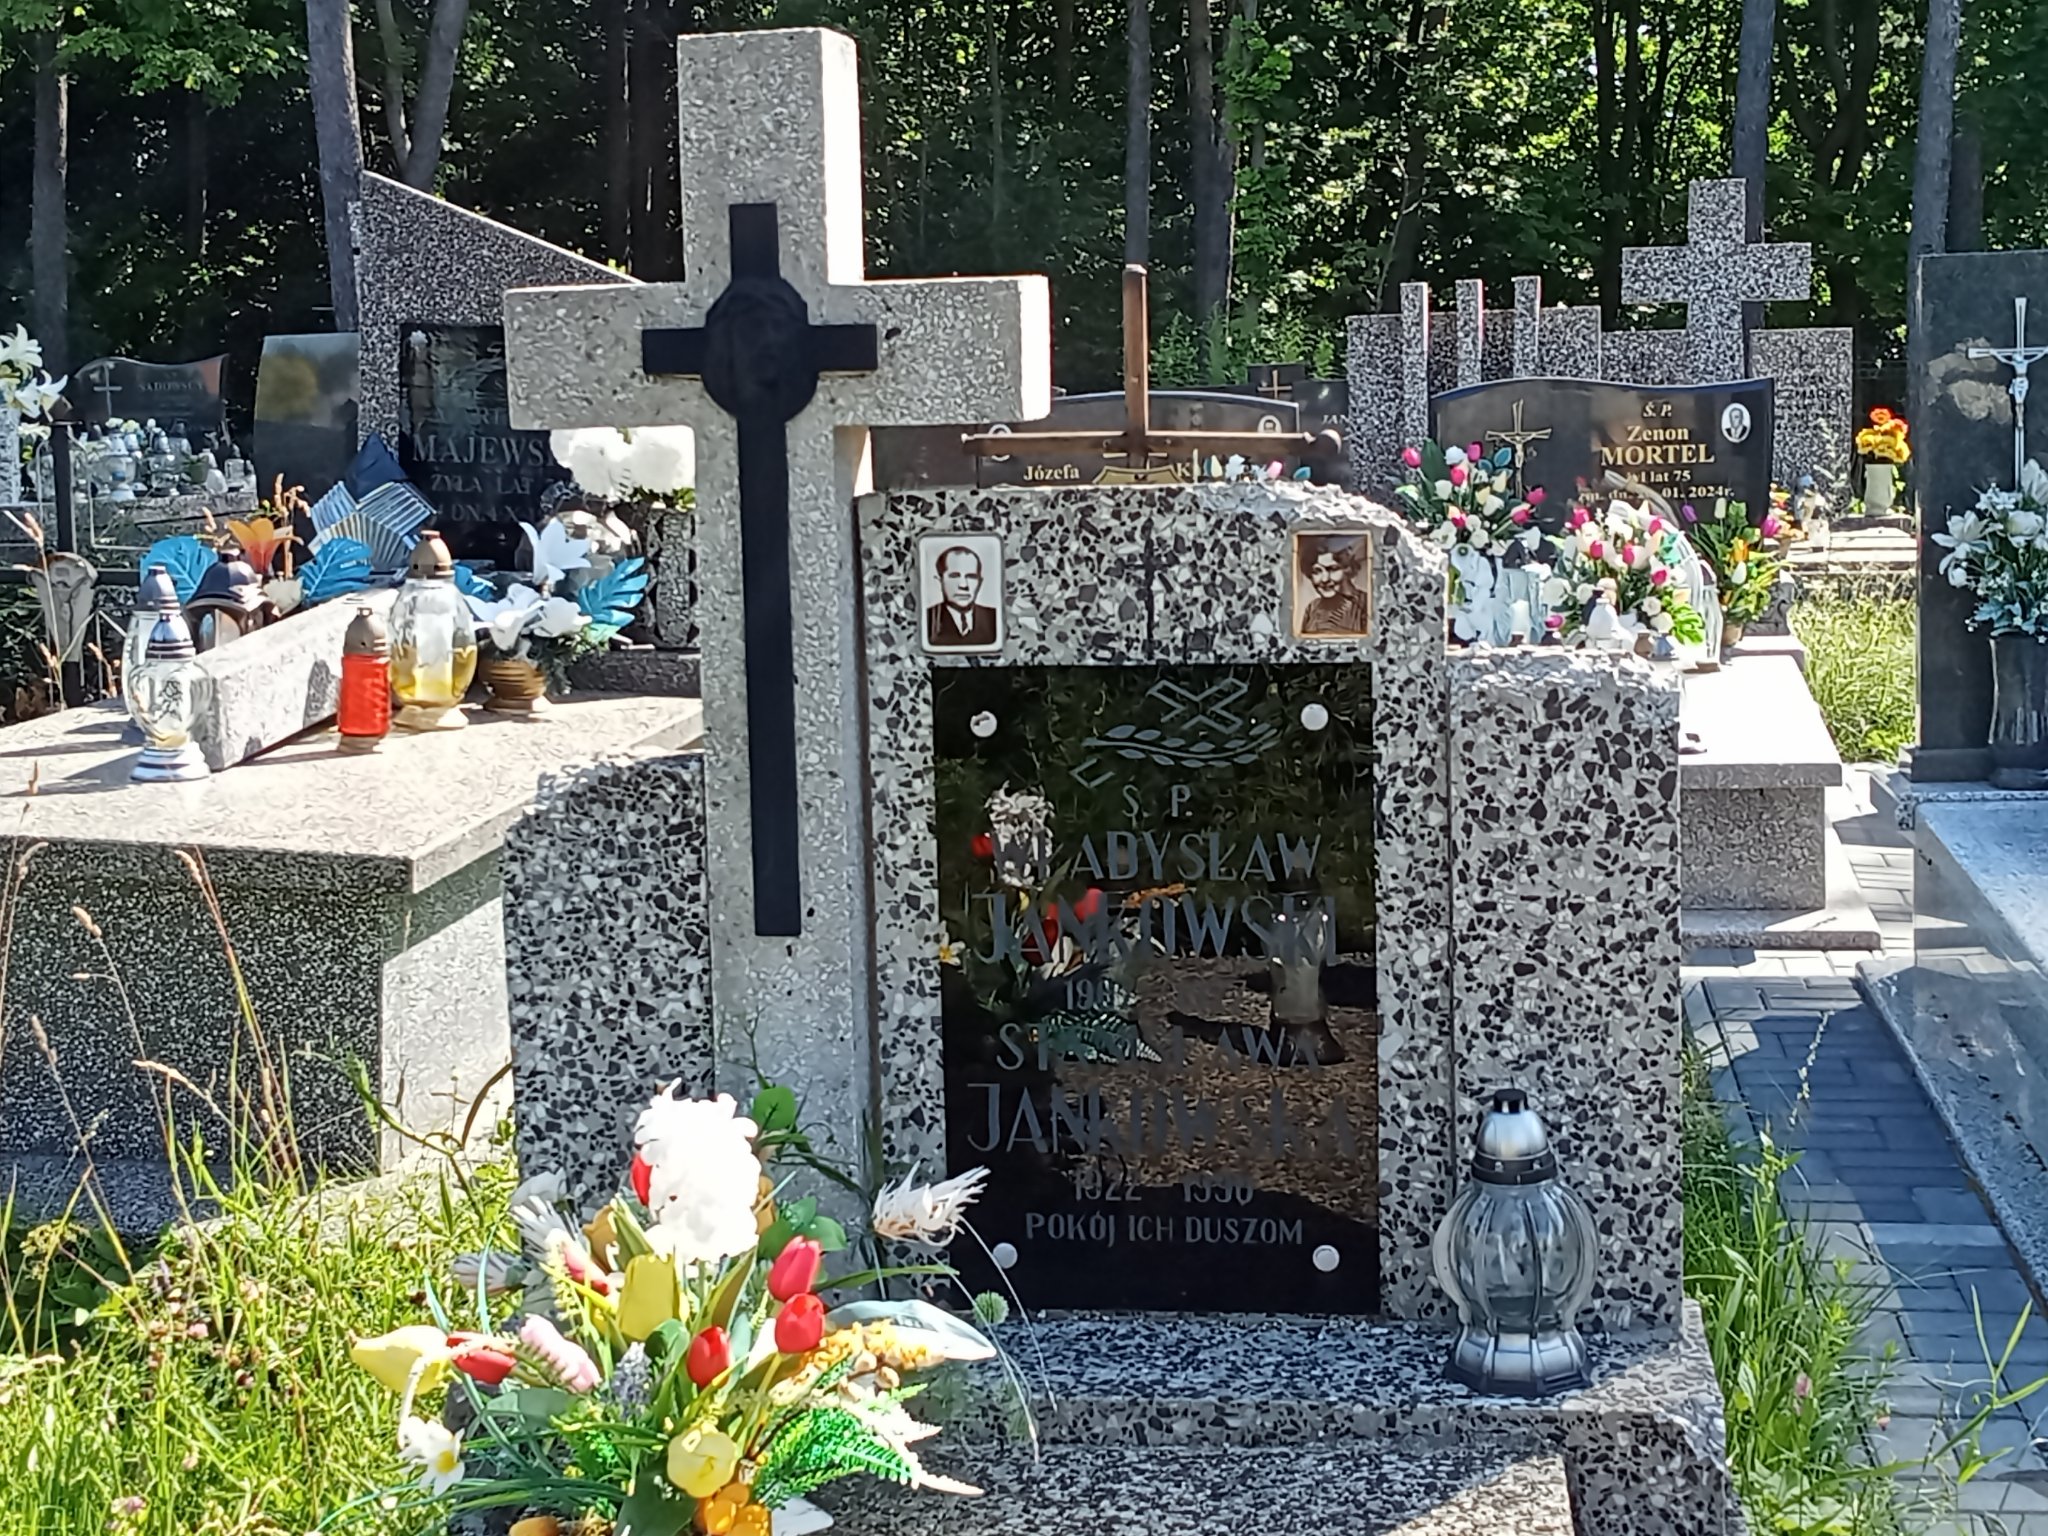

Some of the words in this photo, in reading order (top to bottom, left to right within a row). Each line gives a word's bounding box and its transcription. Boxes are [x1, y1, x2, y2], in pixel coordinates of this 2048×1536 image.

[1626, 425, 1690, 442] Zenon
[412, 433, 554, 467] MAJEWS
[1600, 443, 1716, 467] MORTEL
[1023, 464, 1080, 481] Józefa
[1651, 471, 1669, 483] lat
[1673, 470, 1691, 482] 75
[1171, 784, 1193, 818] P.
[971, 892, 1337, 966] JANKOWSKI
[1025, 1210, 1117, 1248] POKÓJ
[1128, 1214, 1174, 1242] ICH
[1185, 1215, 1303, 1245] DUSZOM
